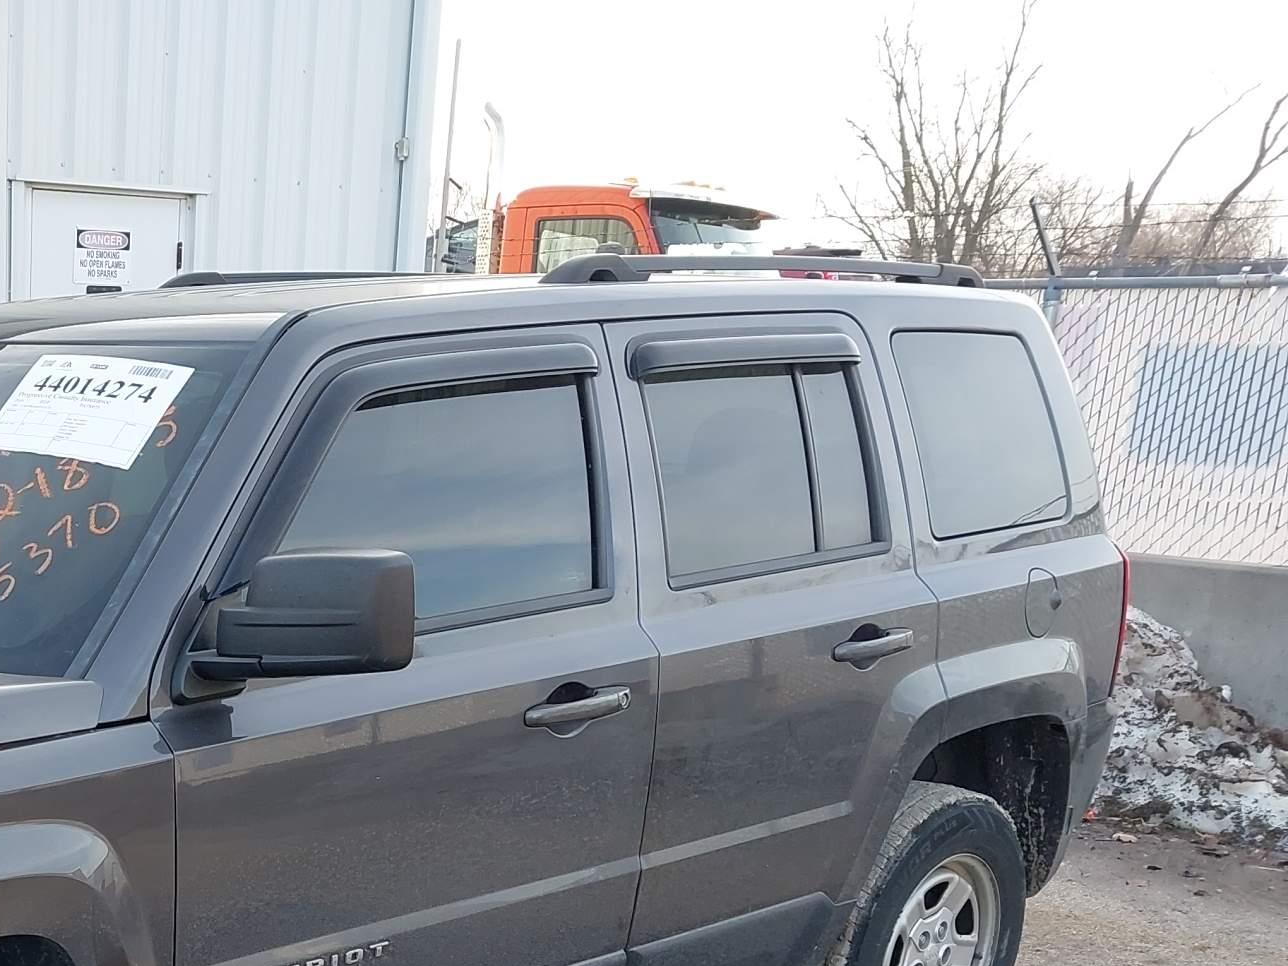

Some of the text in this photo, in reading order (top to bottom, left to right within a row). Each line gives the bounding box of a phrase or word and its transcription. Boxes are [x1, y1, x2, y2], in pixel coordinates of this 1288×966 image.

[85, 234, 122, 245] DANGER
[86, 250, 120, 259] NO SMOKING
[80, 259, 126, 269] NO OPEN FLAMES
[87, 269, 118, 278] NO SPARKS
[34, 375, 157, 403] 44014274
